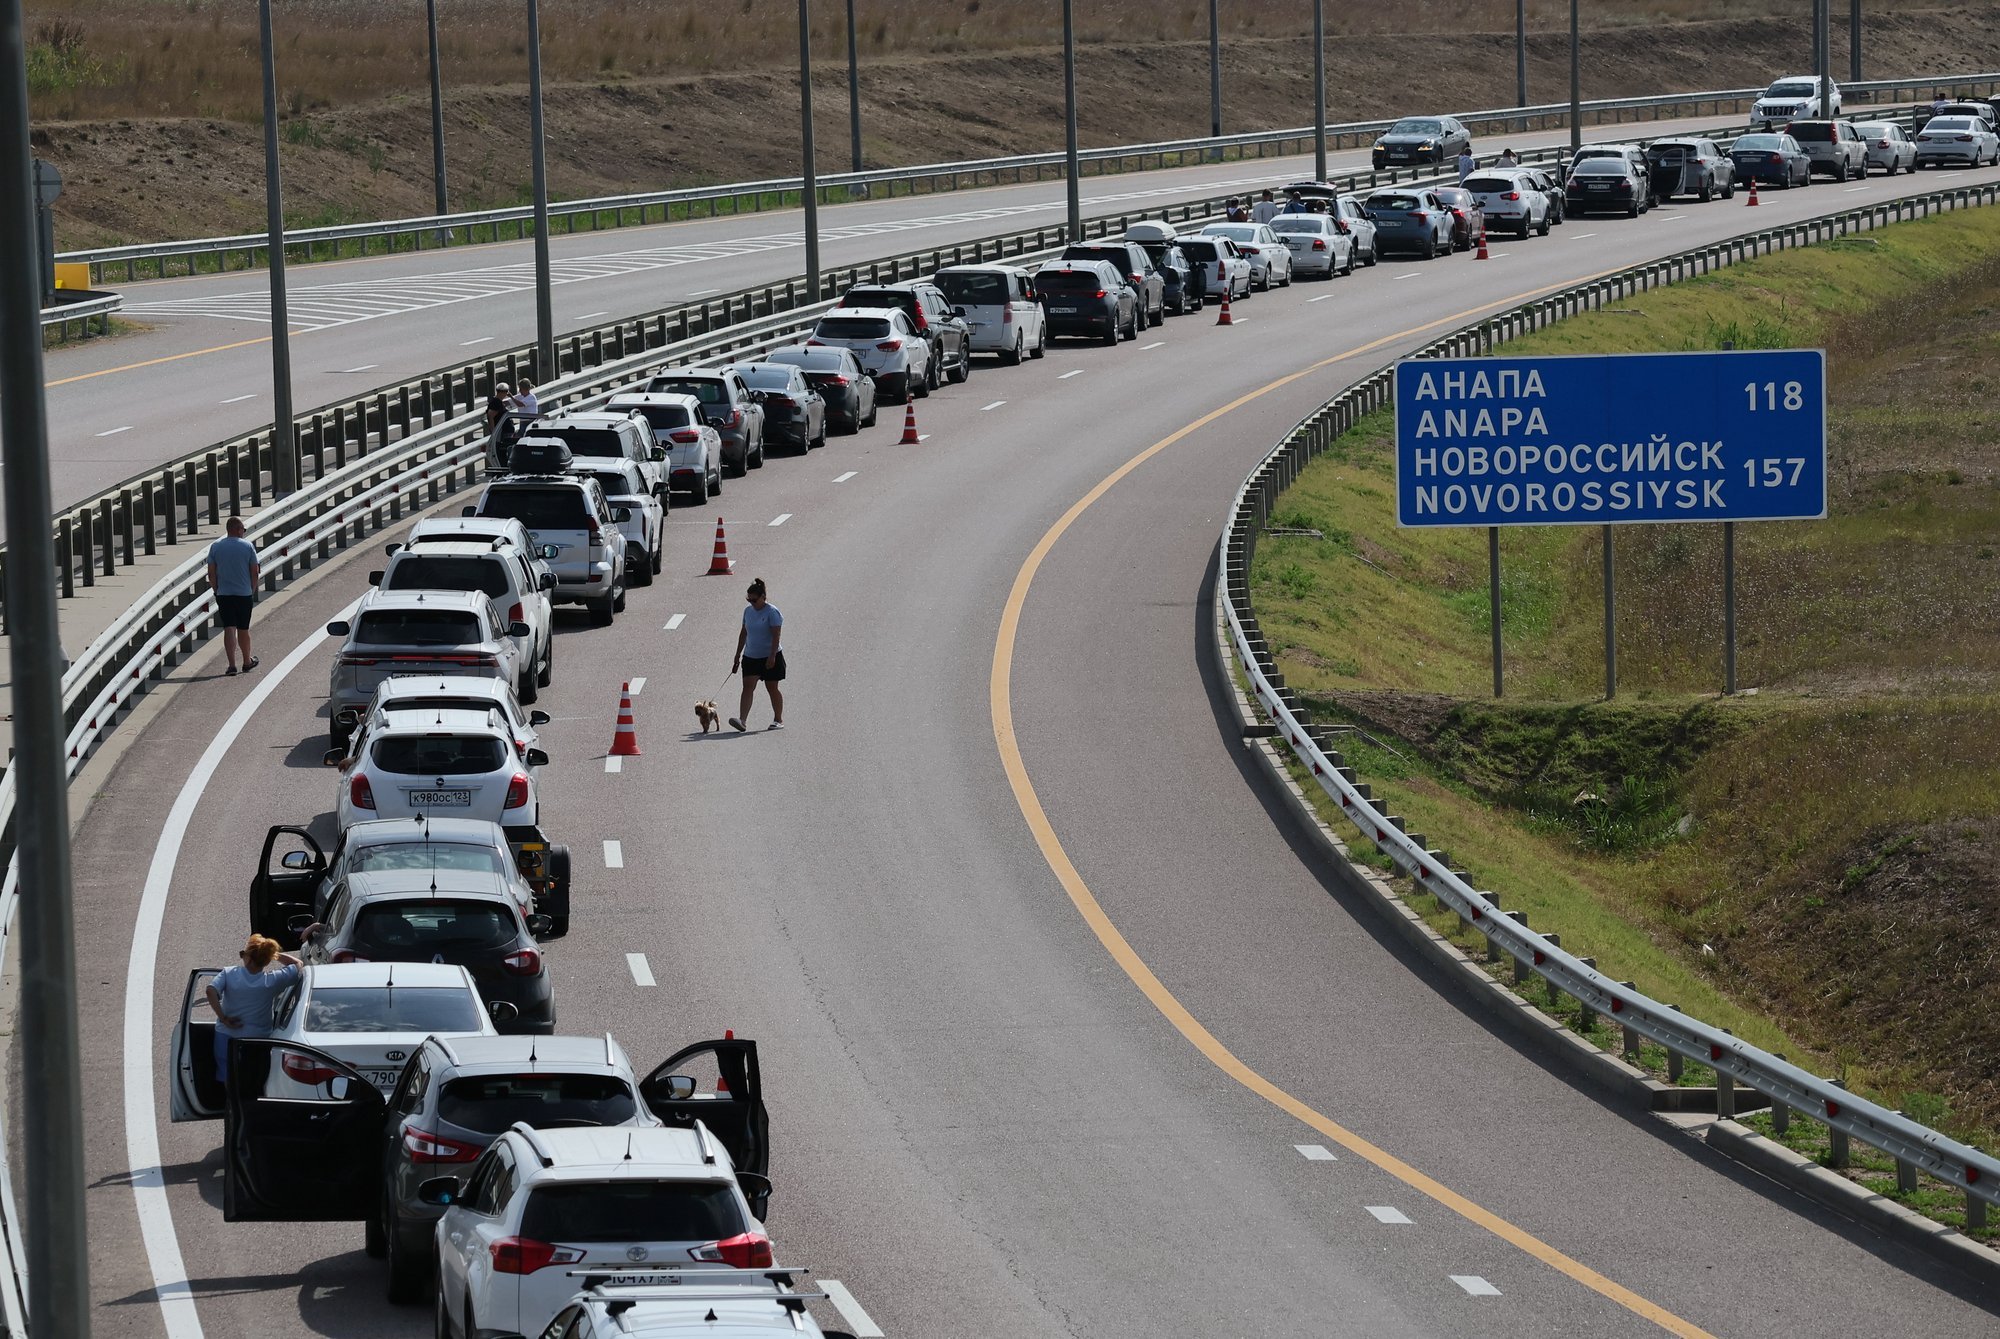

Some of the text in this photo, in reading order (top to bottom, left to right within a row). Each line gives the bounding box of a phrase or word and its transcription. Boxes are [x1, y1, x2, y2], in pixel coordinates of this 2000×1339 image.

[1415, 369, 1547, 400] АНАПА
[1744, 381, 1804, 411] 118
[1415, 407, 1548, 438] ANAPA
[1415, 434, 1726, 477] НОВОРОССИЙСК
[1743, 457, 1806, 488] 157
[1416, 479, 1727, 514] NOVOROSSIYSK
[388, 1052, 403, 1060] KIA
